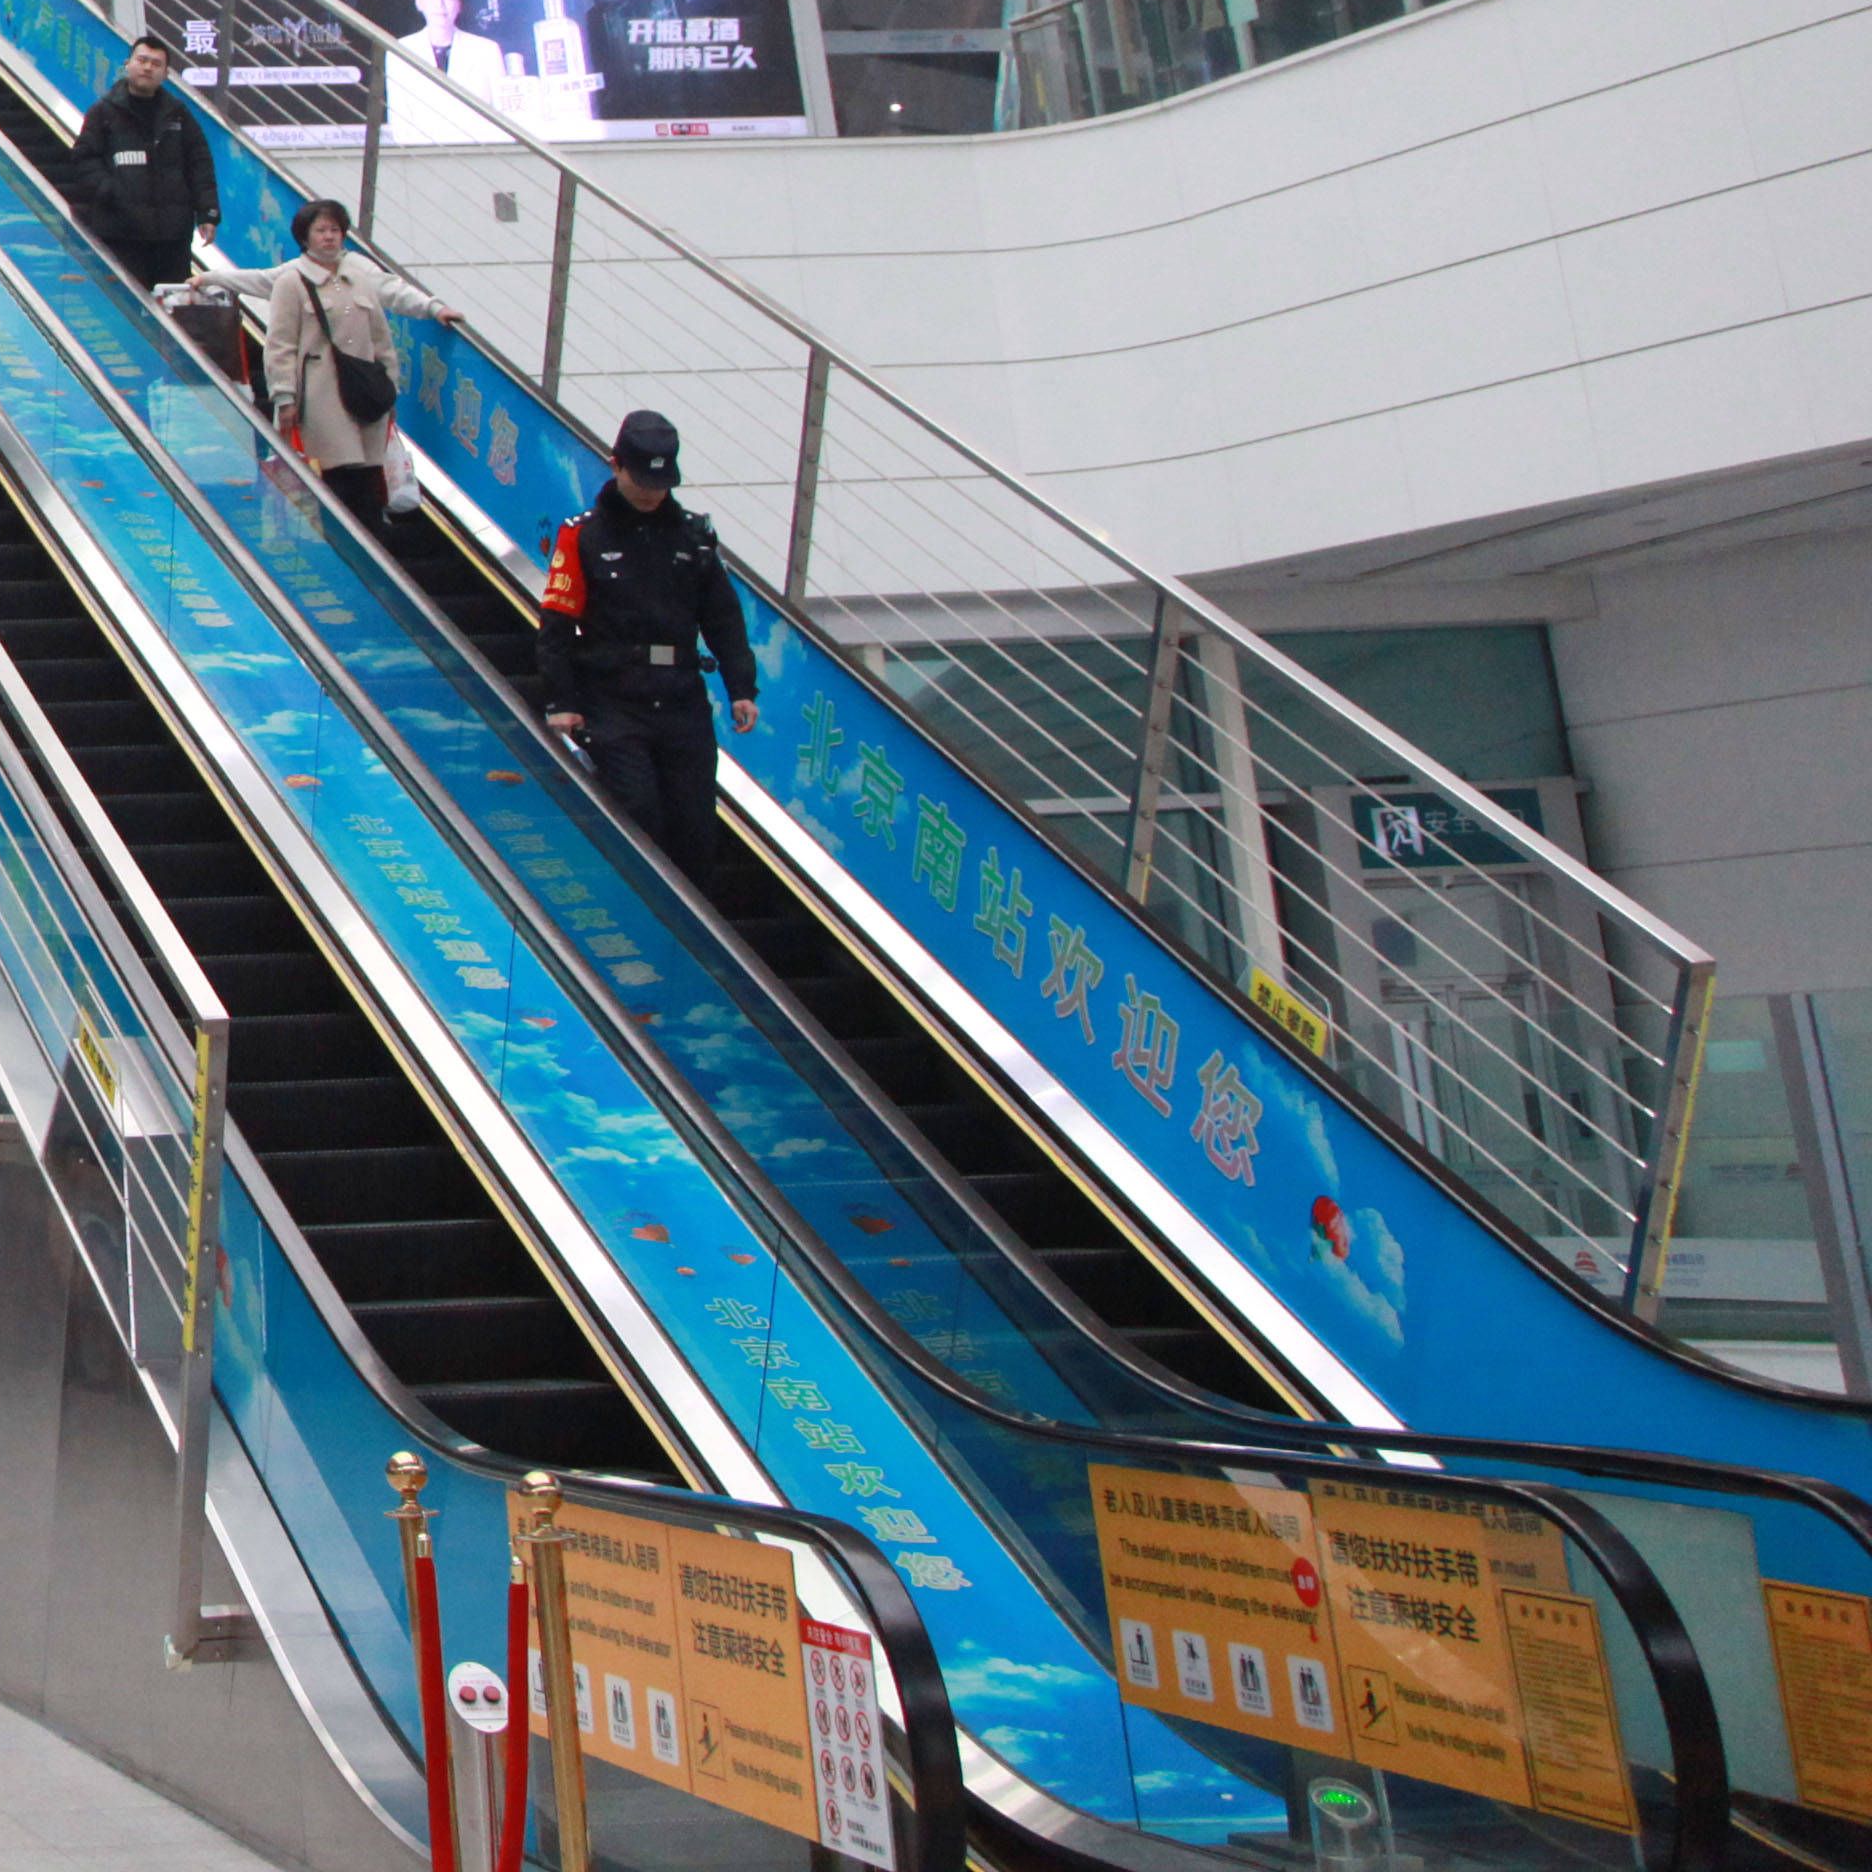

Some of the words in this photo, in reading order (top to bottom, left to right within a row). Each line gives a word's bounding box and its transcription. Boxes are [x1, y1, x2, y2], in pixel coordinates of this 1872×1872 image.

[182, 19, 219, 55] 最
[628, 17, 740, 44] 开瓶最酒
[648, 45, 757, 72] 期待已久
[796, 689, 1263, 1188] 北京南站欢迎您
[704, 1296, 974, 1592] 北京南站欢迎您
[1328, 1530, 1479, 1588] 请您扶好扶手带
[679, 1561, 789, 1623] 请您扶好扶手带
[1347, 1584, 1481, 1644] 注意乘梯安全
[691, 1616, 787, 1678] 注意乘梯安全
